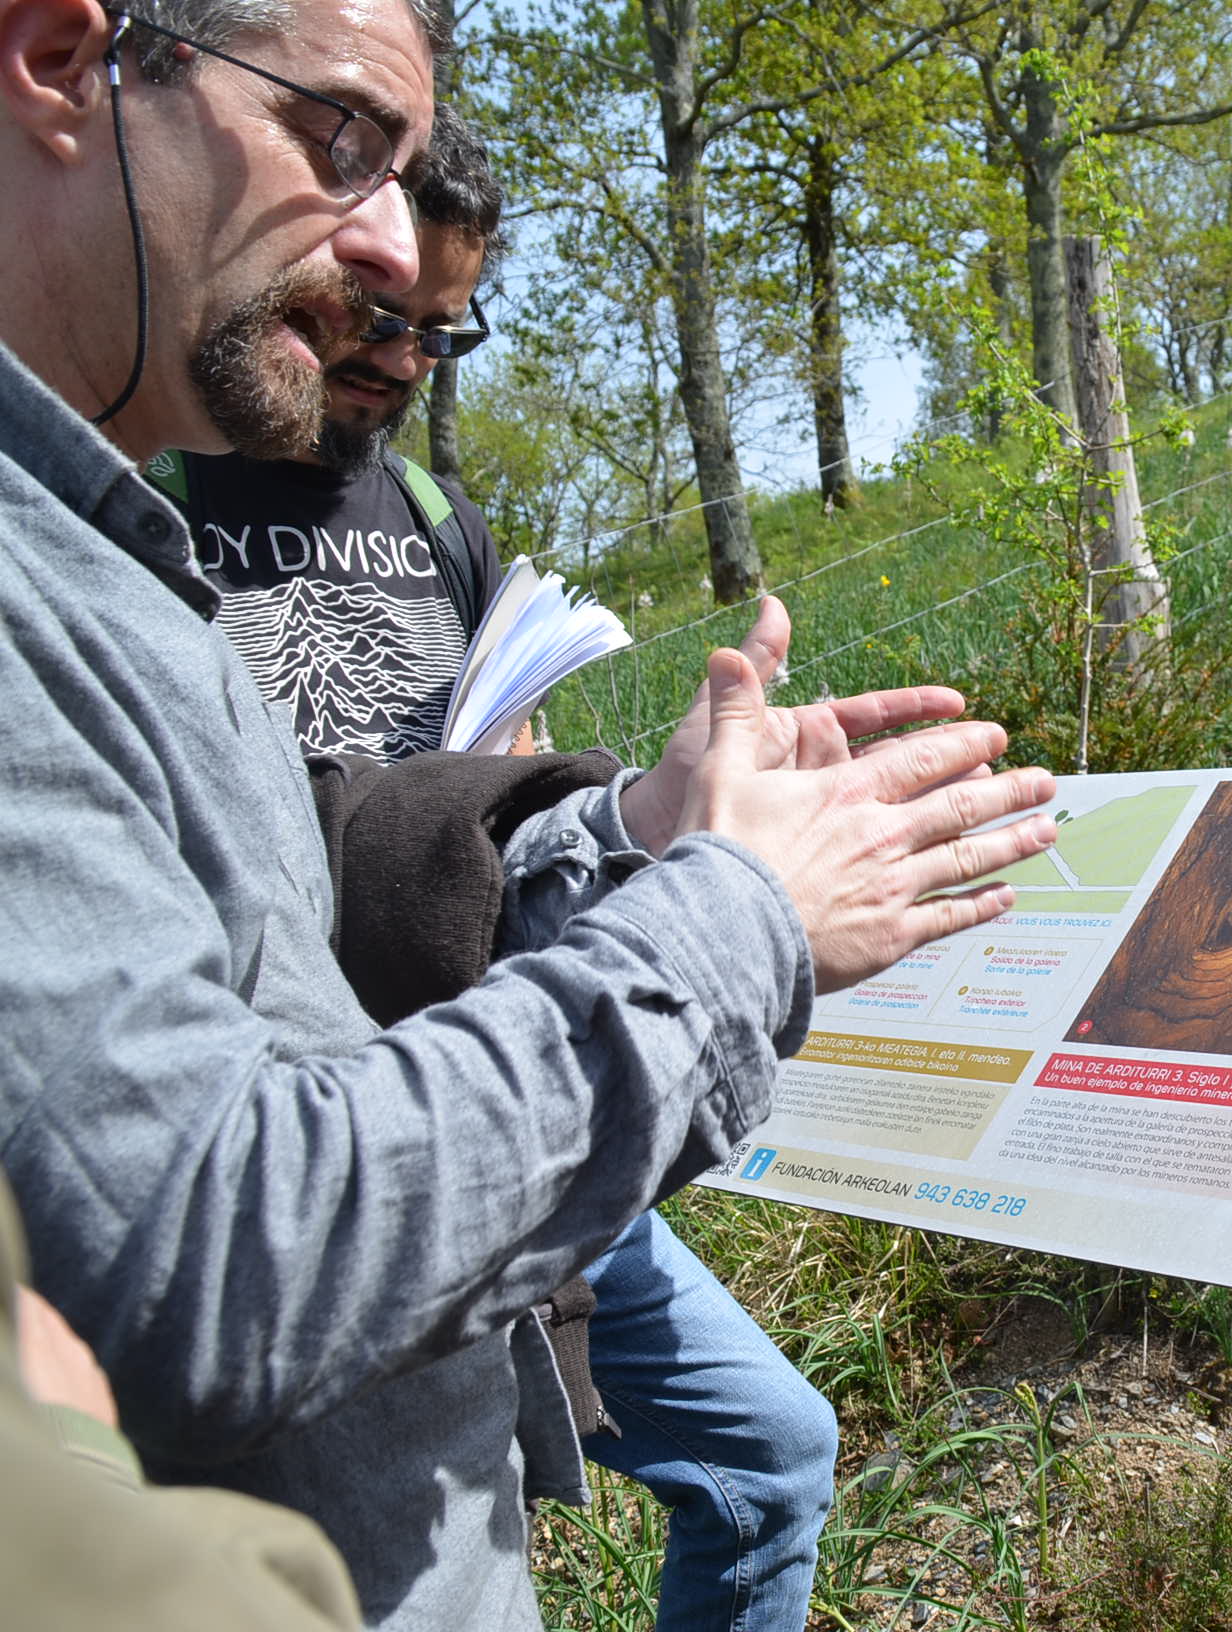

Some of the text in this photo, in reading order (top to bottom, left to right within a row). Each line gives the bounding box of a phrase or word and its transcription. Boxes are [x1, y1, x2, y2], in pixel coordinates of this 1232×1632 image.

[267, 525, 437, 578] DIVISIO
[1044, 1073, 1059, 1081] Un
[1060, 1075, 1086, 1084] buen
[1087, 1078, 1128, 1090] ejemplo
[1128, 1081, 1144, 1090] de
[1051, 1060, 1085, 1071] MINA
[1085, 1063, 1104, 1073] DE
[1103, 1064, 1172, 1079] ARDITURRI
[1187, 1071, 1221, 1085] Siglo
[1087, 1103, 1099, 1111] de
[1108, 1106, 1130, 1114] mina
[1141, 1109, 1159, 1117] han
[1160, 1110, 1212, 1123] descubierto
[1213, 1116, 1227, 1125] los
[1125, 1118, 1137, 1126] de
[1175, 1123, 1187, 1132] de
[772, 1161, 1028, 1217] FUNDACIÓN ARKEOLAN 943 638 218
